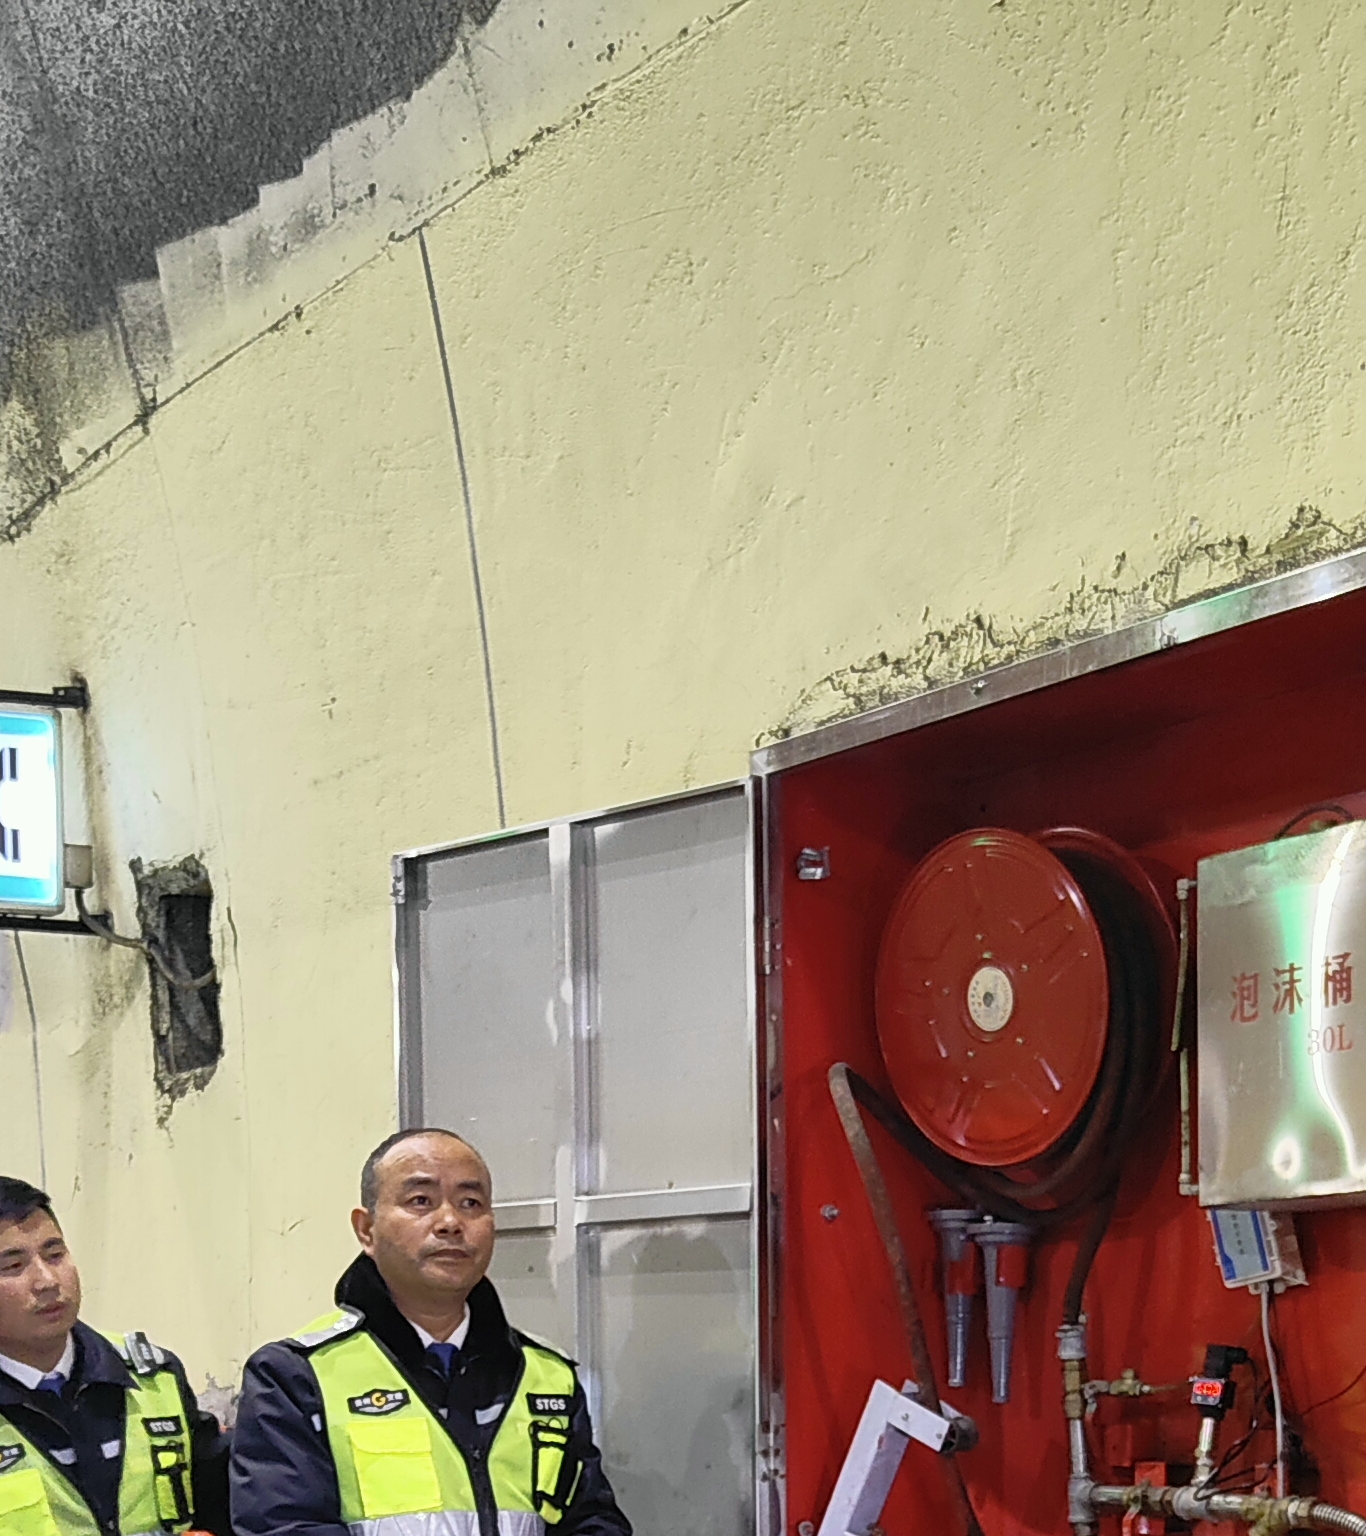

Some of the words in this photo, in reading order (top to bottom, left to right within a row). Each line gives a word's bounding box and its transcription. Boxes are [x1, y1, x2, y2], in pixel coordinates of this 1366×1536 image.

[1230, 951, 1353, 1023] 泡沫桶
[1306, 1023, 1353, 1056] 30L
[535, 1397, 567, 1411] STGS
